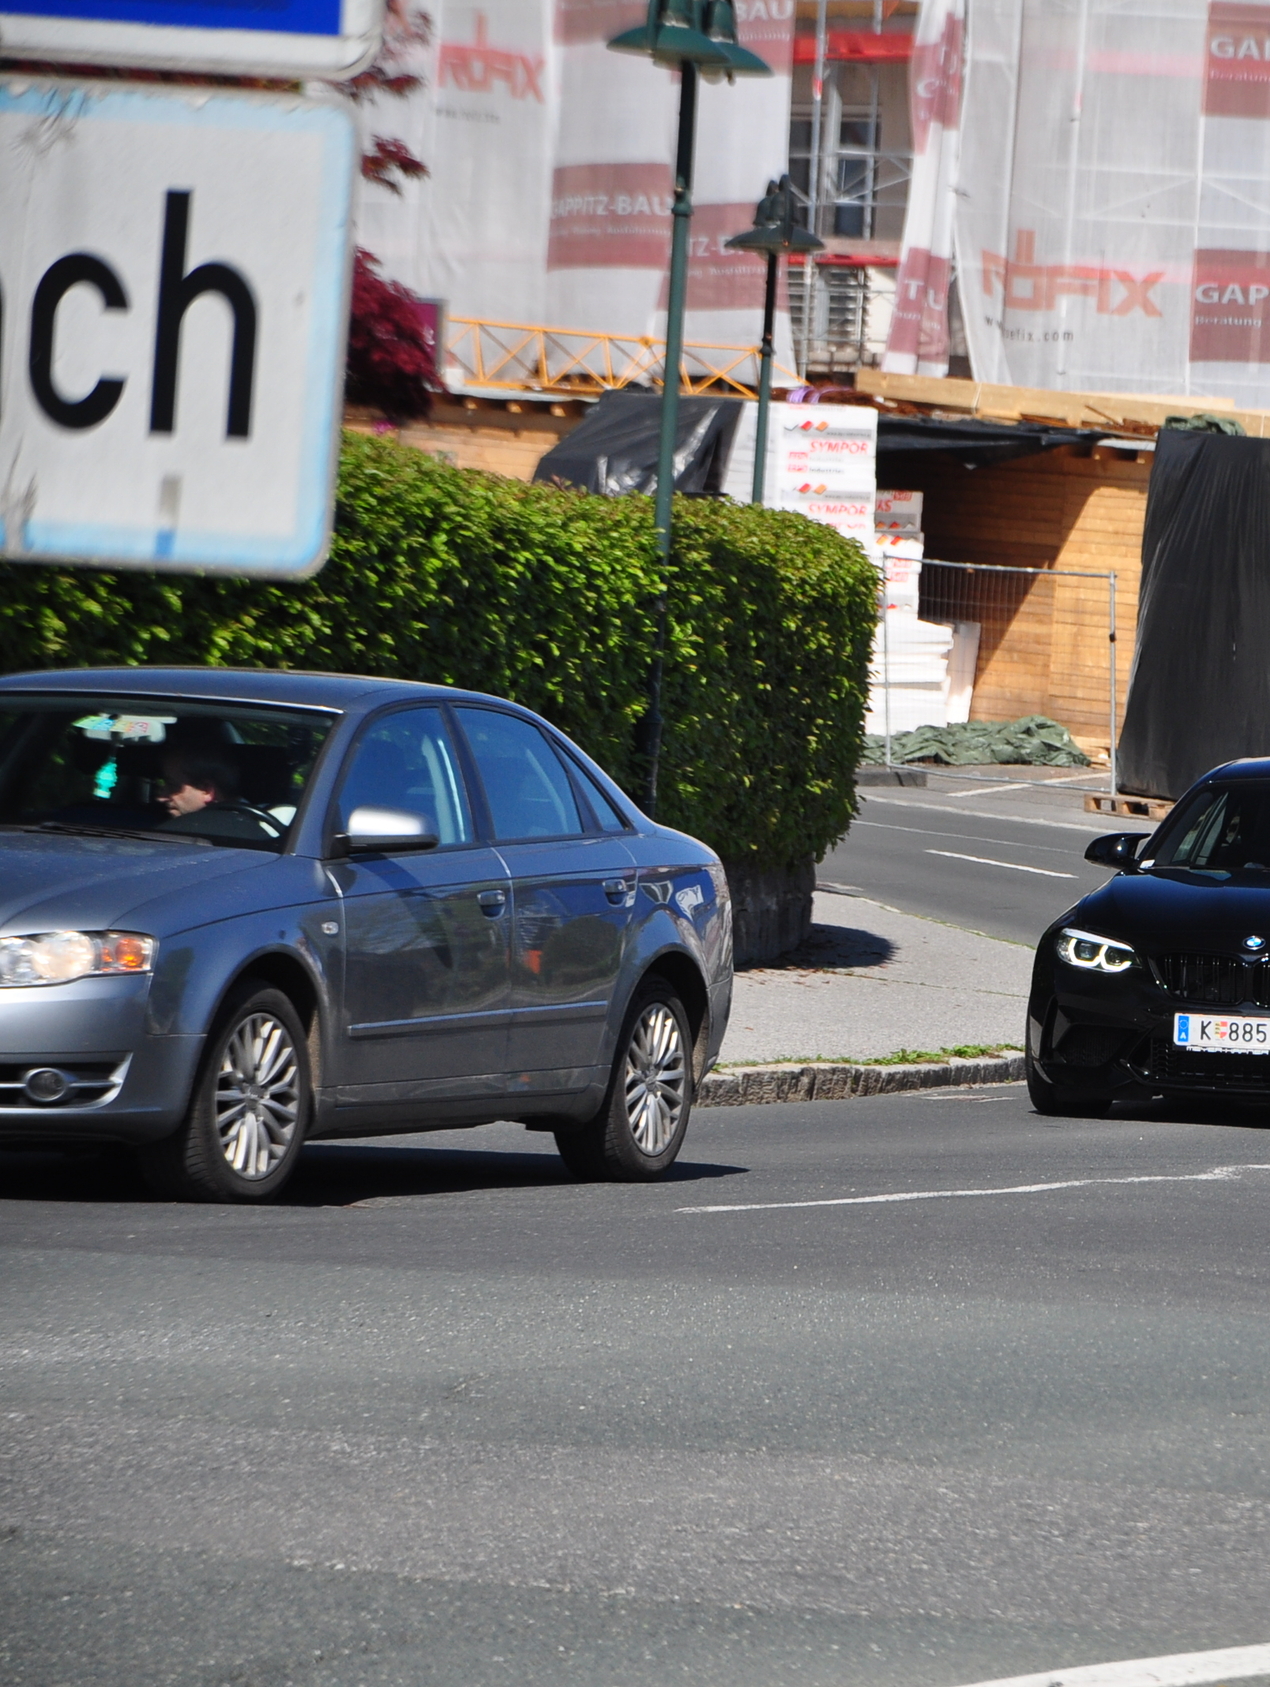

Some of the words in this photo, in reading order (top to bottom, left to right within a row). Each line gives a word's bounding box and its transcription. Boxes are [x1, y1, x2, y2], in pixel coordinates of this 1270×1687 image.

[0, 187, 256, 440] ch
[1195, 315, 1262, 328] Beratung
[809, 441, 869, 455] SYMPOR
[1200, 1020, 1212, 1041] K
[1228, 1022, 1267, 1043] 885
